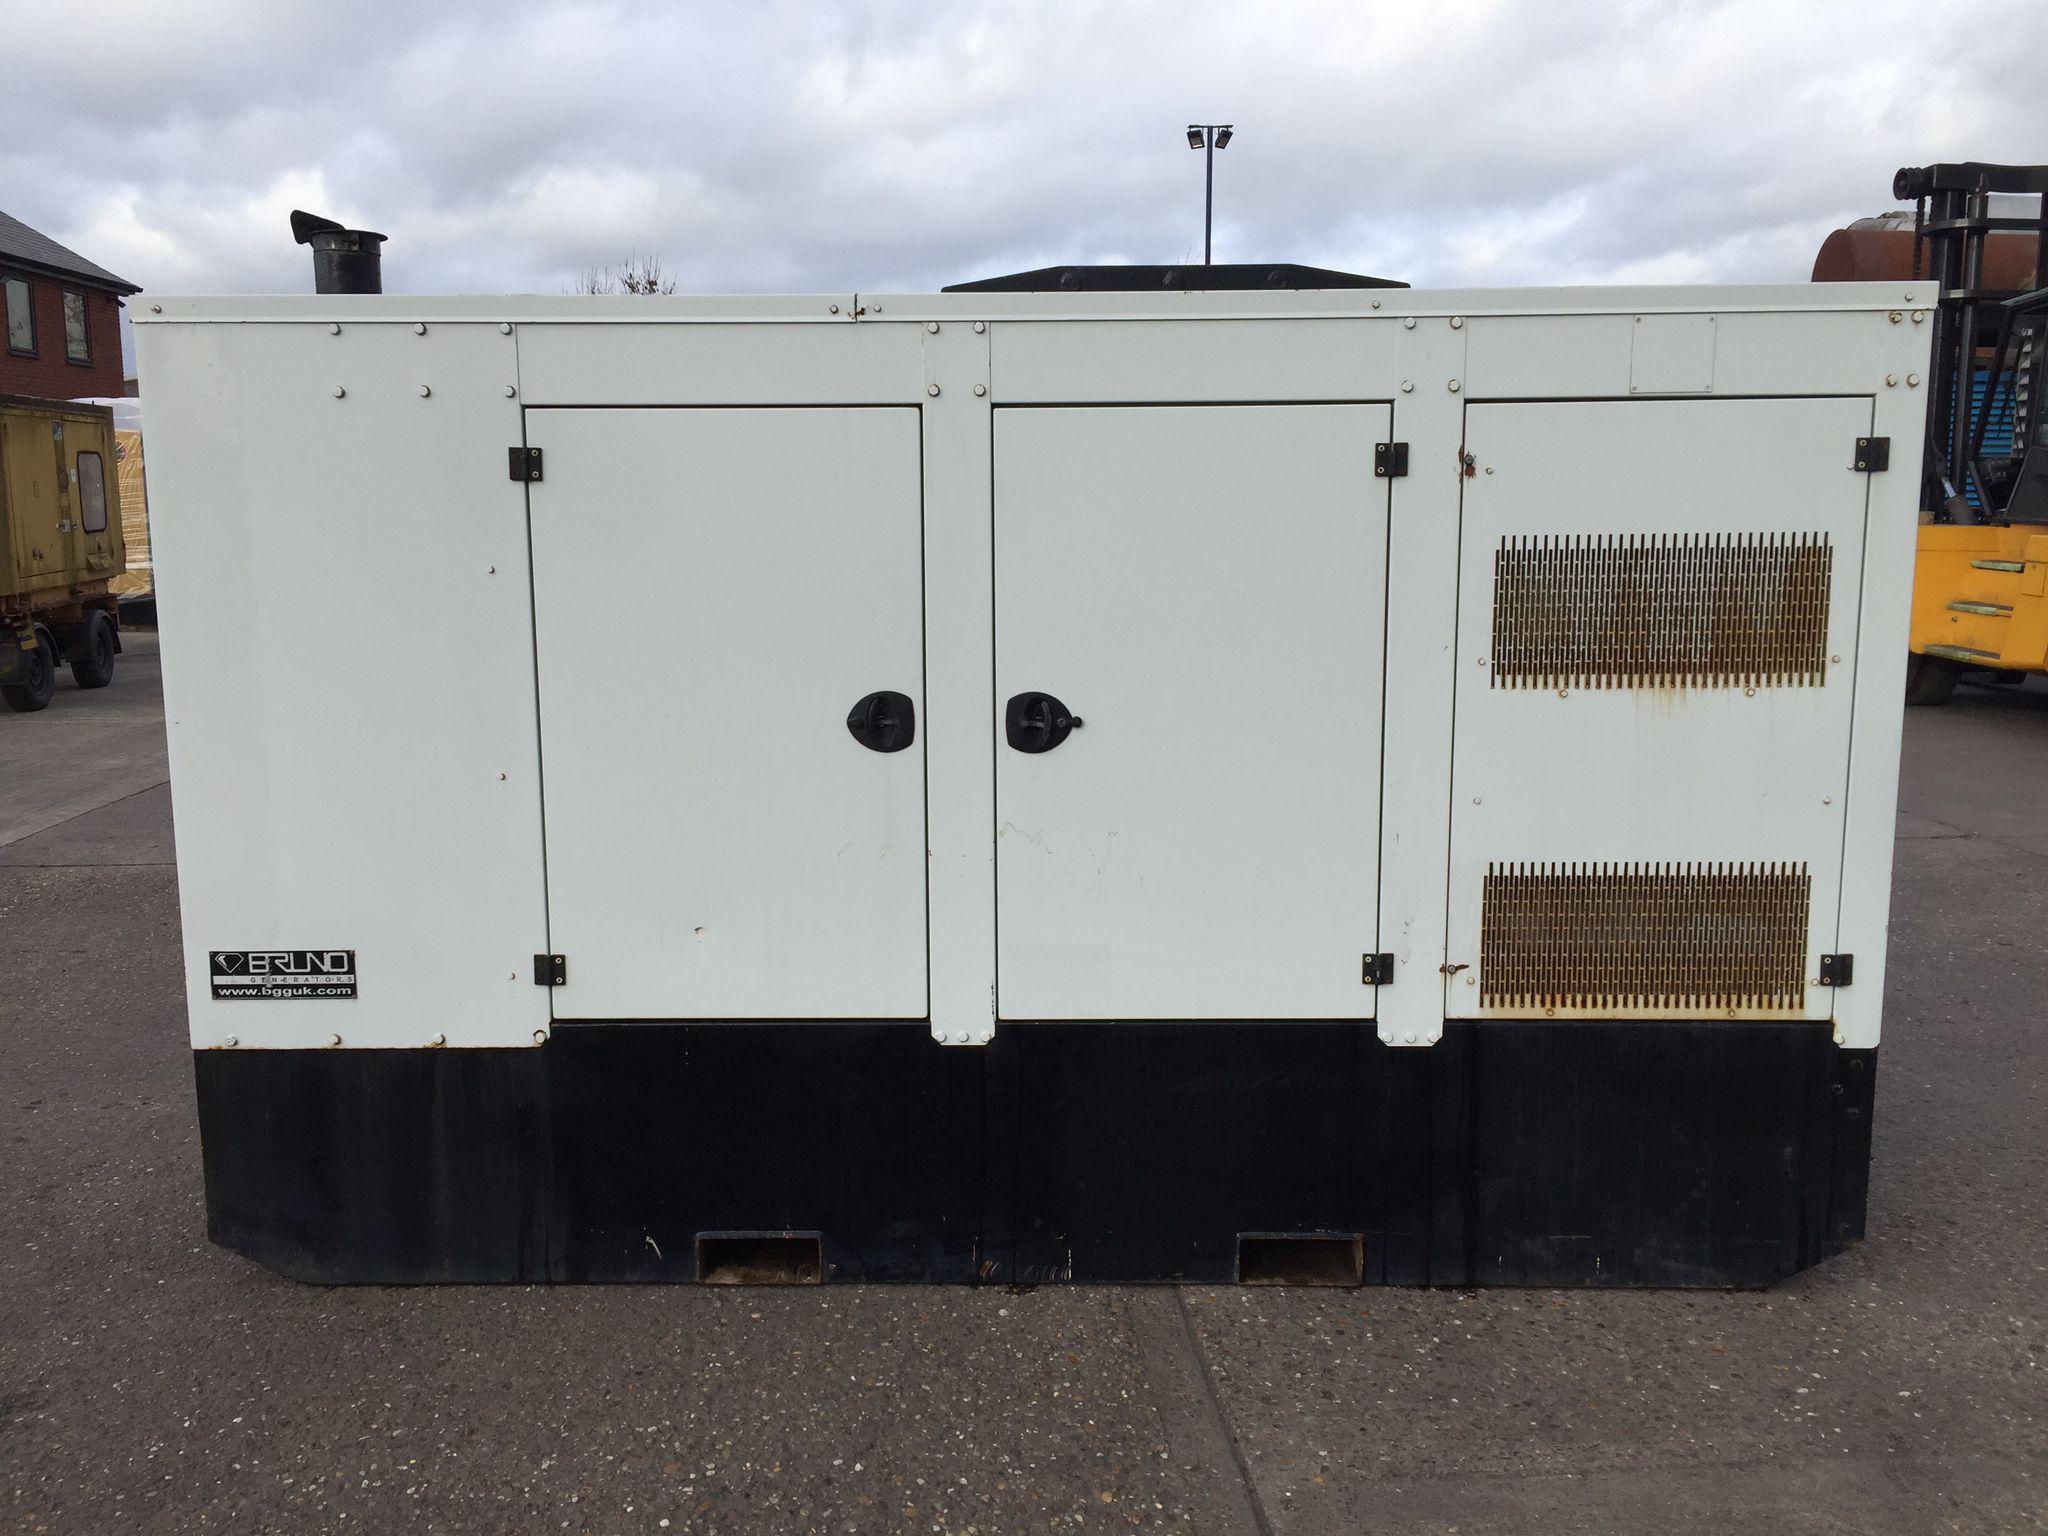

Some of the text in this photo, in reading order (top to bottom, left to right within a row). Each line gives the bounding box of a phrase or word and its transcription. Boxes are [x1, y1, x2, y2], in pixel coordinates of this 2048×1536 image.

[248, 952, 349, 973] BRUNO
[250, 976, 353, 984] GENERATORS
[218, 987, 351, 997] www.bgguk.com
